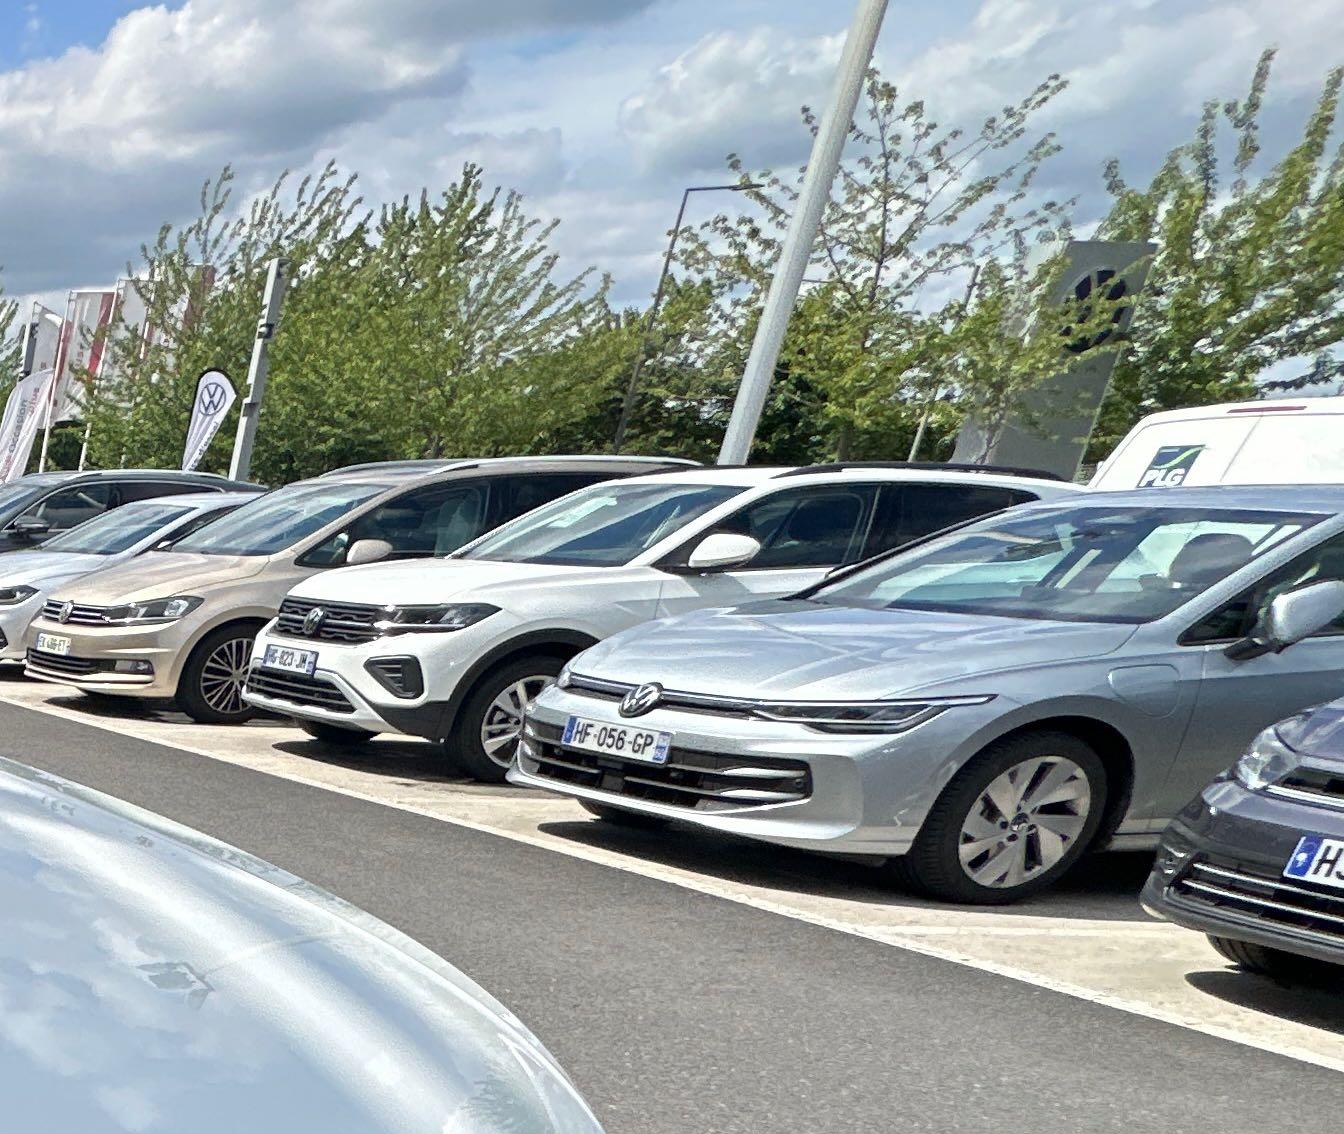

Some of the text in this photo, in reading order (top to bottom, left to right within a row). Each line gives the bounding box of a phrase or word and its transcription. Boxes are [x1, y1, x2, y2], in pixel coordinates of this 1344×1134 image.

[1138, 468, 1186, 487] PLG
[573, 721, 655, 755] HF-056-GP
[1311, 845, 1344, 881] H
